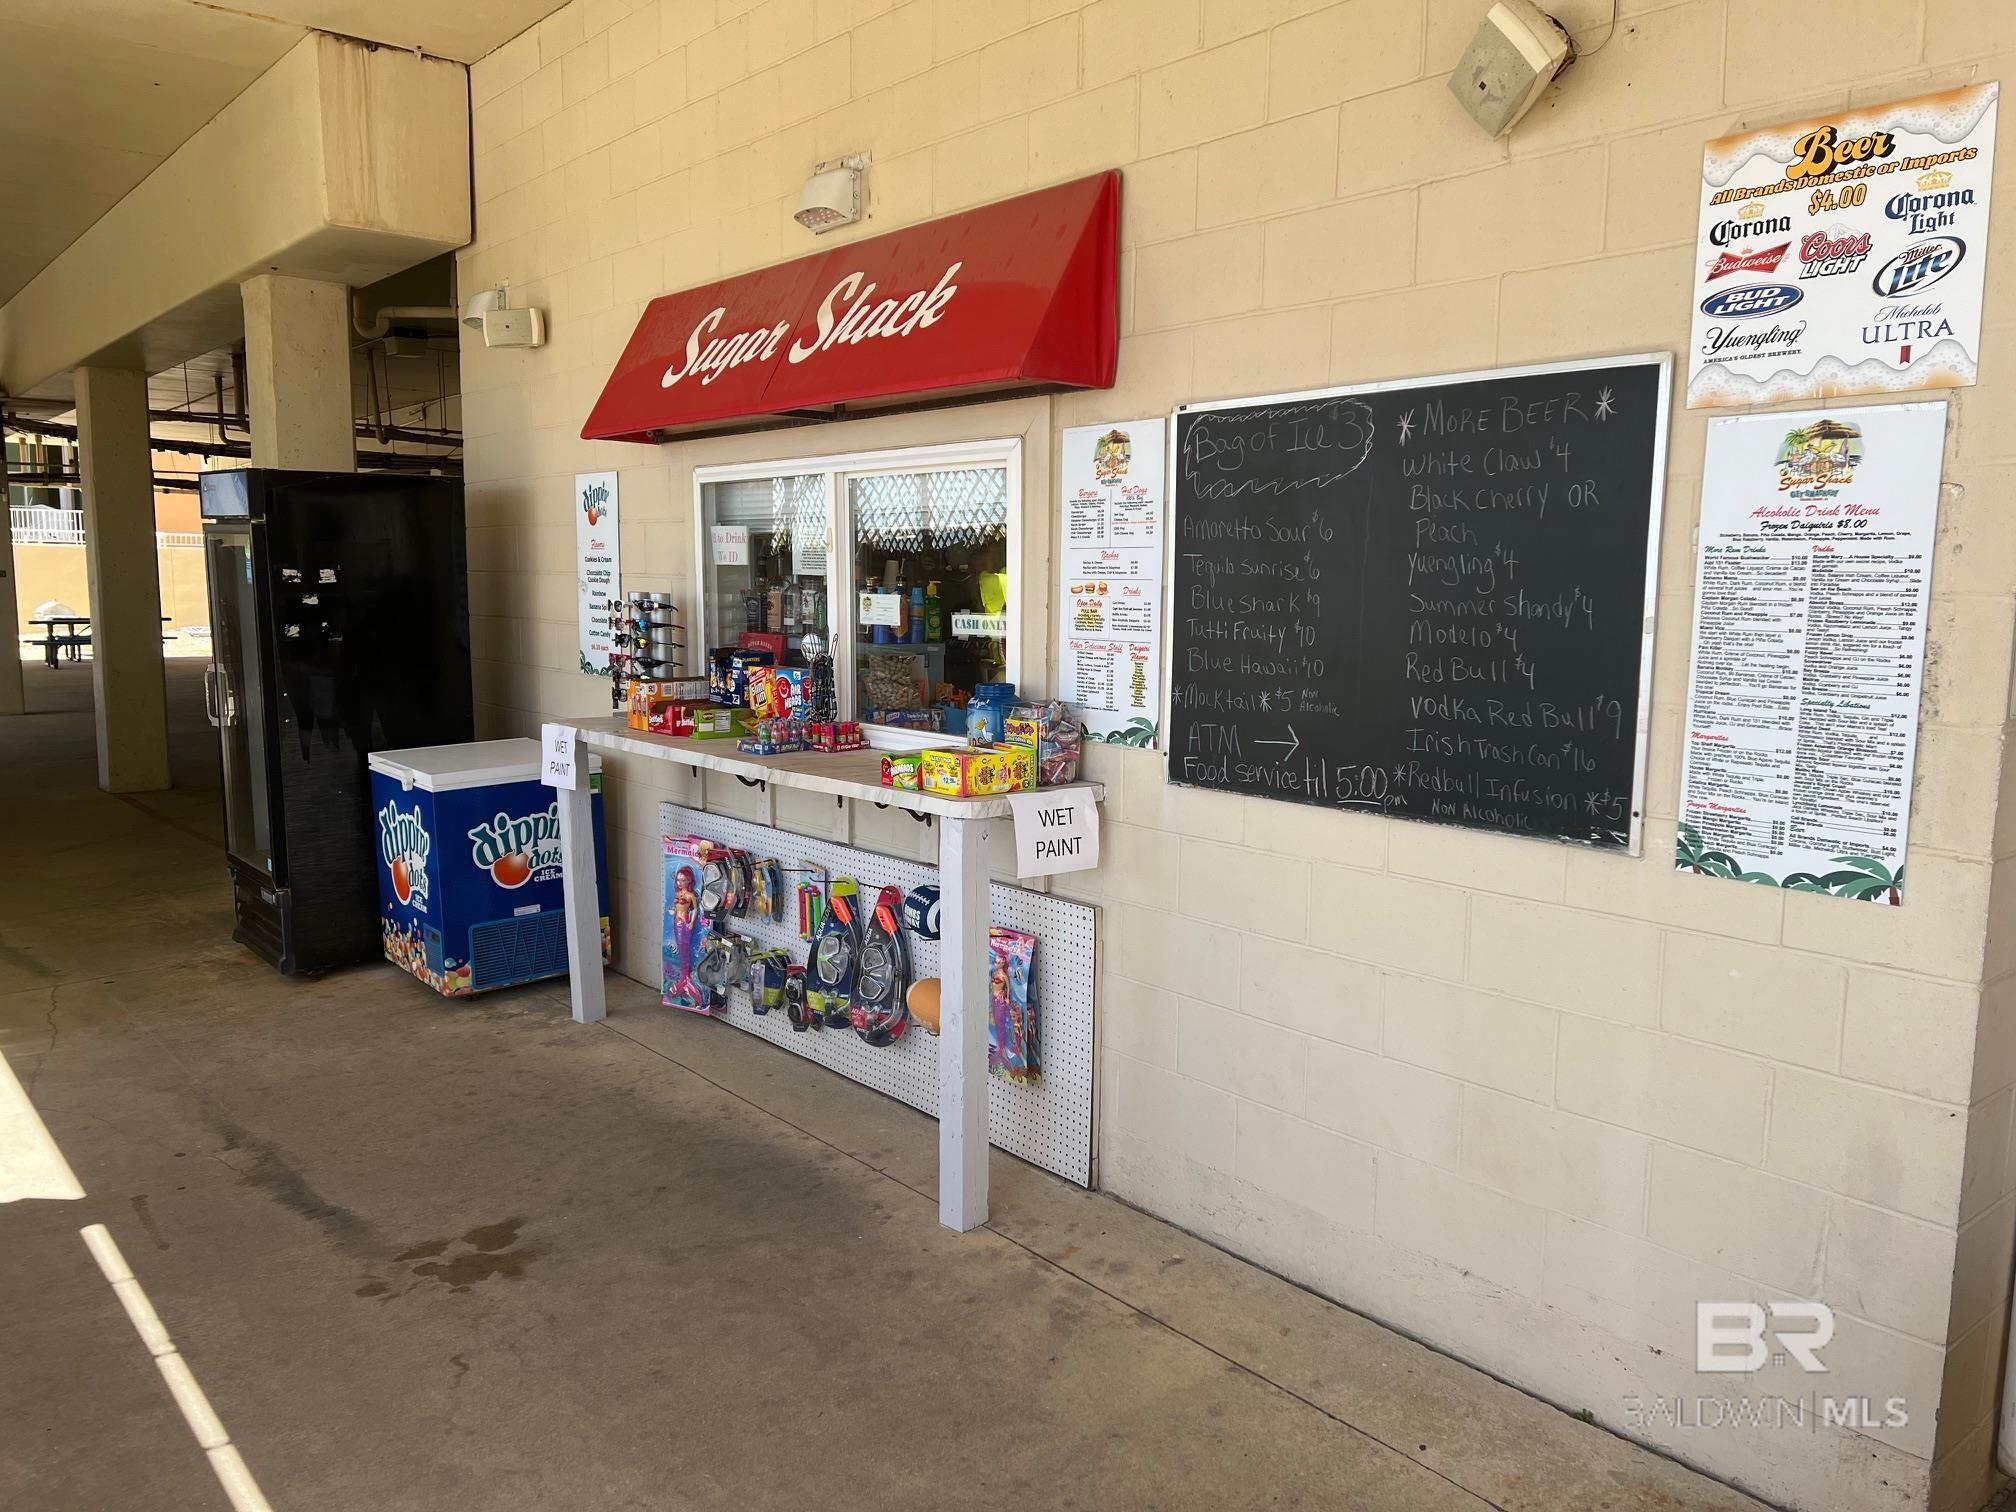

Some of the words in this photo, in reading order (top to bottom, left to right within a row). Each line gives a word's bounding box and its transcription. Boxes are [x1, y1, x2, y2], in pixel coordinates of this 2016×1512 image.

[1786, 125, 1896, 180] Beer
[1710, 190, 1734, 205] All
[1735, 180, 1794, 202] Brands
[1795, 164, 1875, 189] Domestic
[1878, 160, 1899, 175] or
[1901, 147, 1978, 170] Imports
[1808, 184, 1867, 216] $4.00
[1885, 188, 1976, 221] Corona
[1709, 213, 1792, 248] Corona
[1908, 212, 1956, 236] Light
[1800, 231, 1872, 263] Coors
[1899, 244, 1942, 264] Miller
[1799, 254, 1867, 280] LIGHT
[1886, 247, 1953, 296] Lite
[1713, 295, 1789, 314] LIGHT
[1724, 286, 1780, 302] BUD
[661, 306, 791, 388] Sugar
[788, 260, 963, 364] Shack
[1873, 303, 1941, 323] Michelob
[1702, 320, 1807, 355] Yuengling
[1862, 318, 1954, 344] ULTRA
[1703, 355, 1738, 364] AMERICA'S
[1740, 353, 1766, 361] OLDEST
[1423, 399, 1493, 435] MORE
[1500, 392, 1589, 432] BEER
[1193, 425, 1246, 471] Bag
[1250, 421, 1280, 452] of
[1286, 417, 1334, 452] Ice
[1329, 406, 1364, 450] $3
[1402, 451, 1475, 477] White
[1484, 447, 1542, 476] Claw
[1549, 436, 1573, 472] $4
[1778, 475, 1815, 491] Sugar
[1813, 473, 1854, 490] Shack
[1409, 483, 1471, 513] Black
[1475, 482, 1549, 520] Cherry
[1568, 479, 1600, 508] OR
[1749, 505, 1801, 518] Alcoholic
[1805, 504, 1840, 517] Drink
[1844, 503, 1880, 516] Menu
[726, 532, 747, 543] Drink
[1265, 516, 1312, 542] Sour
[1312, 508, 1333, 542] $6
[1415, 516, 1479, 549] Peach
[1760, 520, 1789, 532] Frozen
[1837, 518, 1868, 529] $8.00
[729, 550, 738, 563] ID
[1725, 545, 1741, 553] Rum
[1743, 545, 1767, 553] Drinks
[586, 569, 603, 577] Chocolate
[603, 569, 611, 577] Chip
[599, 577, 610, 585] Dough
[1184, 554, 1235, 588] Tequila
[1408, 552, 1496, 595] Yuengling
[1495, 540, 1520, 581] $4
[1191, 585, 1235, 614] Blue
[1409, 593, 1497, 616] Summer
[1574, 585, 1593, 630] $4
[589, 629, 600, 637] Cotton
[600, 630, 611, 638] Candy
[1186, 618, 1228, 639] Tutti
[1233, 621, 1287, 653] Fruity
[1295, 618, 1316, 648] $10
[1410, 619, 1492, 648] Modelo
[1496, 622, 1518, 653] $4
[1187, 646, 1233, 672] Blue
[1240, 653, 1299, 676] Hawaii
[1302, 655, 1325, 678] $10
[1405, 651, 1444, 683] Red
[1450, 656, 1507, 683] Bull
[1514, 653, 1535, 690] $4
[790, 683, 801, 696] AIR
[1801, 697, 1834, 708] Specialty
[1836, 700, 1871, 710] Libations
[1487, 699, 1533, 727] Red
[1539, 702, 1595, 731] Bull
[1596, 694, 1623, 740] $9
[554, 738, 568, 755] WET
[1188, 720, 1242, 758] ATM
[1405, 728, 1472, 757] Irish
[1474, 738, 1525, 766] Trash
[1528, 743, 1560, 770] Can
[1561, 740, 1596, 773] $16
[1690, 730, 1729, 742] Margaritas
[550, 760, 571, 777] PAINT
[1183, 754, 1231, 783] Food
[1304, 756, 1328, 798] til
[1335, 765, 1389, 799] 5:00
[1384, 793, 1408, 814] pm
[1408, 760, 1480, 799] Redbull
[1485, 777, 1577, 810] Infusion
[1602, 788, 1629, 821] $5
[1038, 806, 1075, 828] WET
[1463, 802, 1535, 831] Alcoholic
[530, 846, 563, 869] dots
[667, 845, 700, 858] Mermaid
[1035, 836, 1082, 860] PAINT
[408, 862, 428, 894] dots
[534, 872, 564, 883] CREAM
[816, 921, 826, 941] AQUA
[864, 927, 873, 945] AQUA
